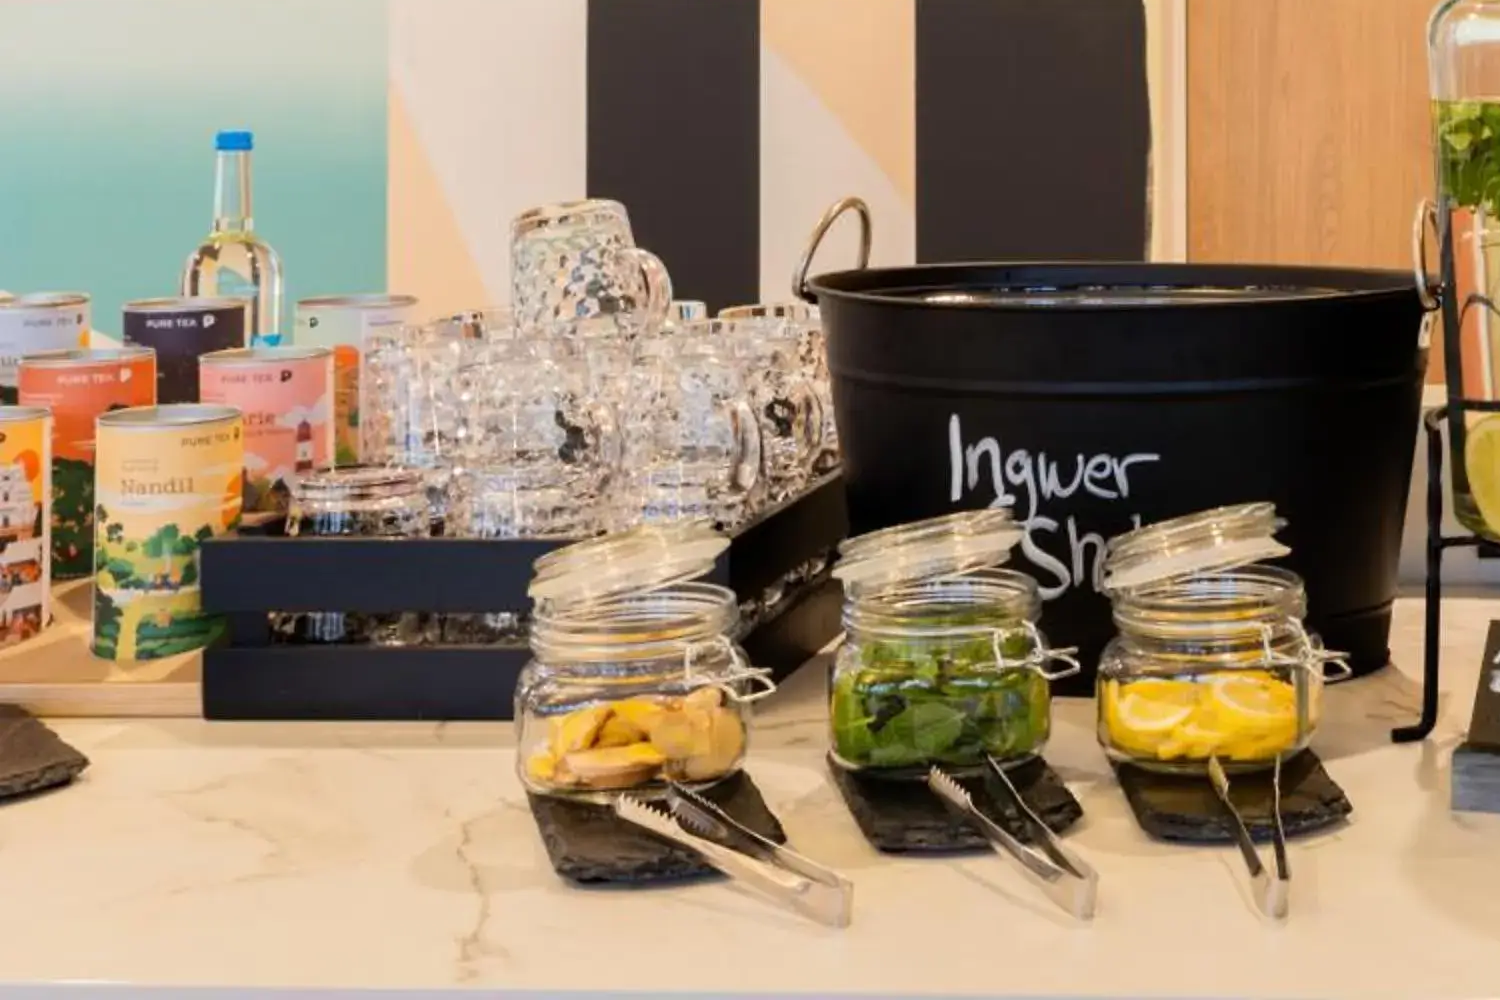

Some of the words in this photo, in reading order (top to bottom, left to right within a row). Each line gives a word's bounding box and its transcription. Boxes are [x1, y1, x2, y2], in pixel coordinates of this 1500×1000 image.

[145, 318, 174, 328] PURE
[176, 317, 197, 328] TEA
[57, 374, 88, 385] PURE
[92, 372, 116, 384] TEA
[221, 374, 248, 383] PURE
[252, 373, 275, 383] TEA
[181, 436, 211, 447] PURE
[948, 412, 1161, 524] Ingwer
[1022, 515, 1142, 600] Sh
